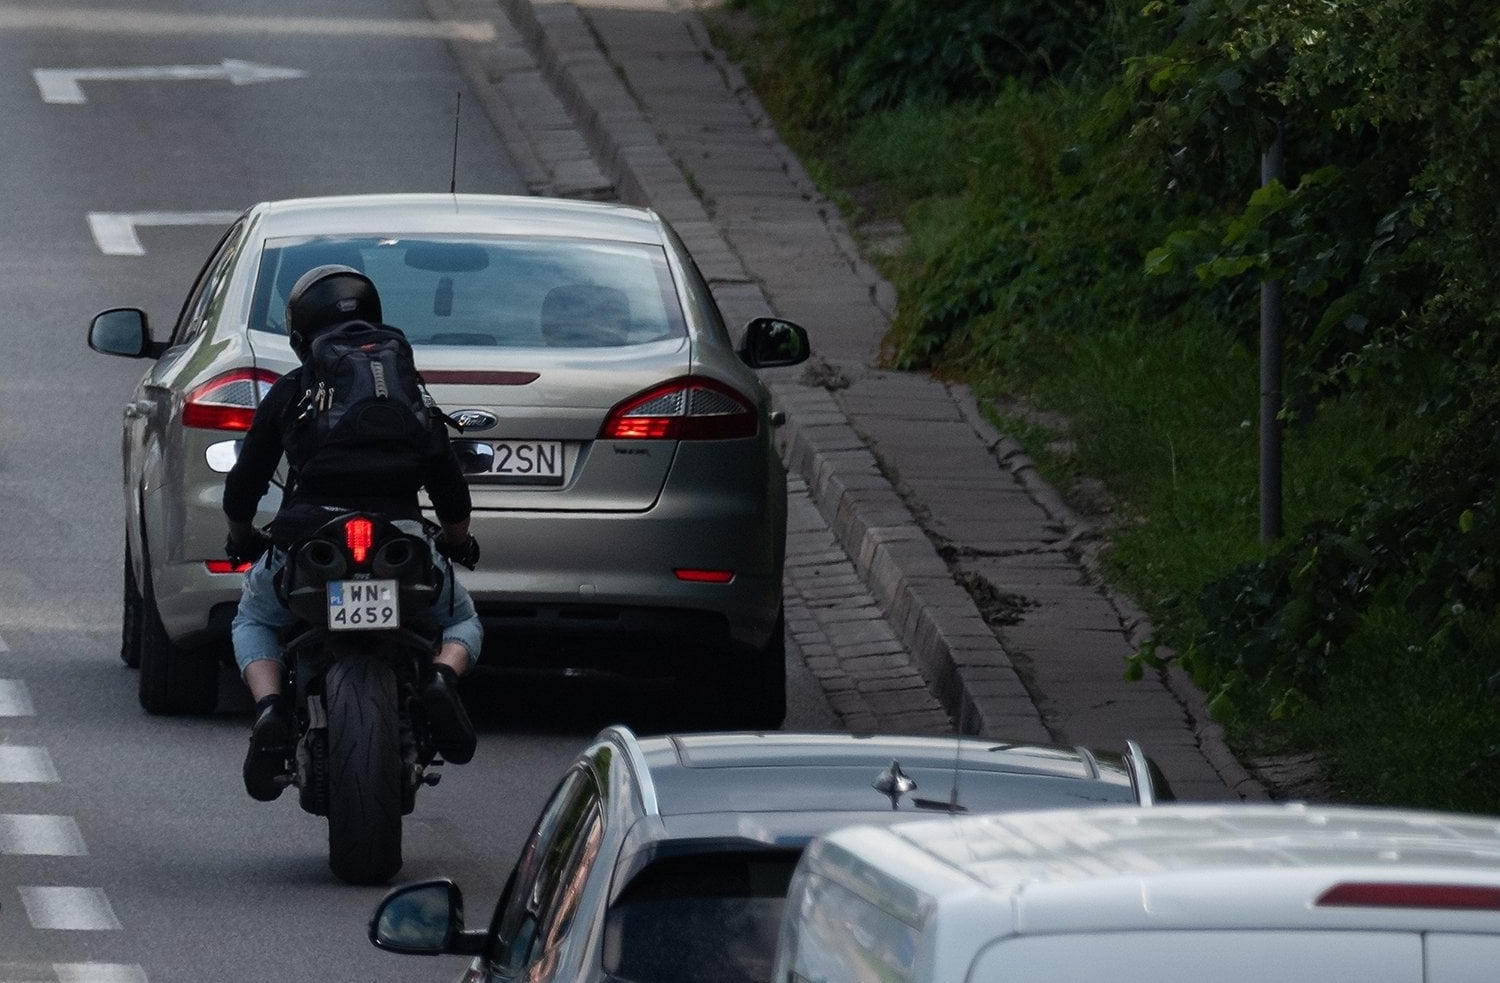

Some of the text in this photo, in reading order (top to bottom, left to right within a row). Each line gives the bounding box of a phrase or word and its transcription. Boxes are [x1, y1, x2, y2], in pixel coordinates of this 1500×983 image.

[330, 585, 379, 605] PL WN
[334, 606, 393, 625] 4659
